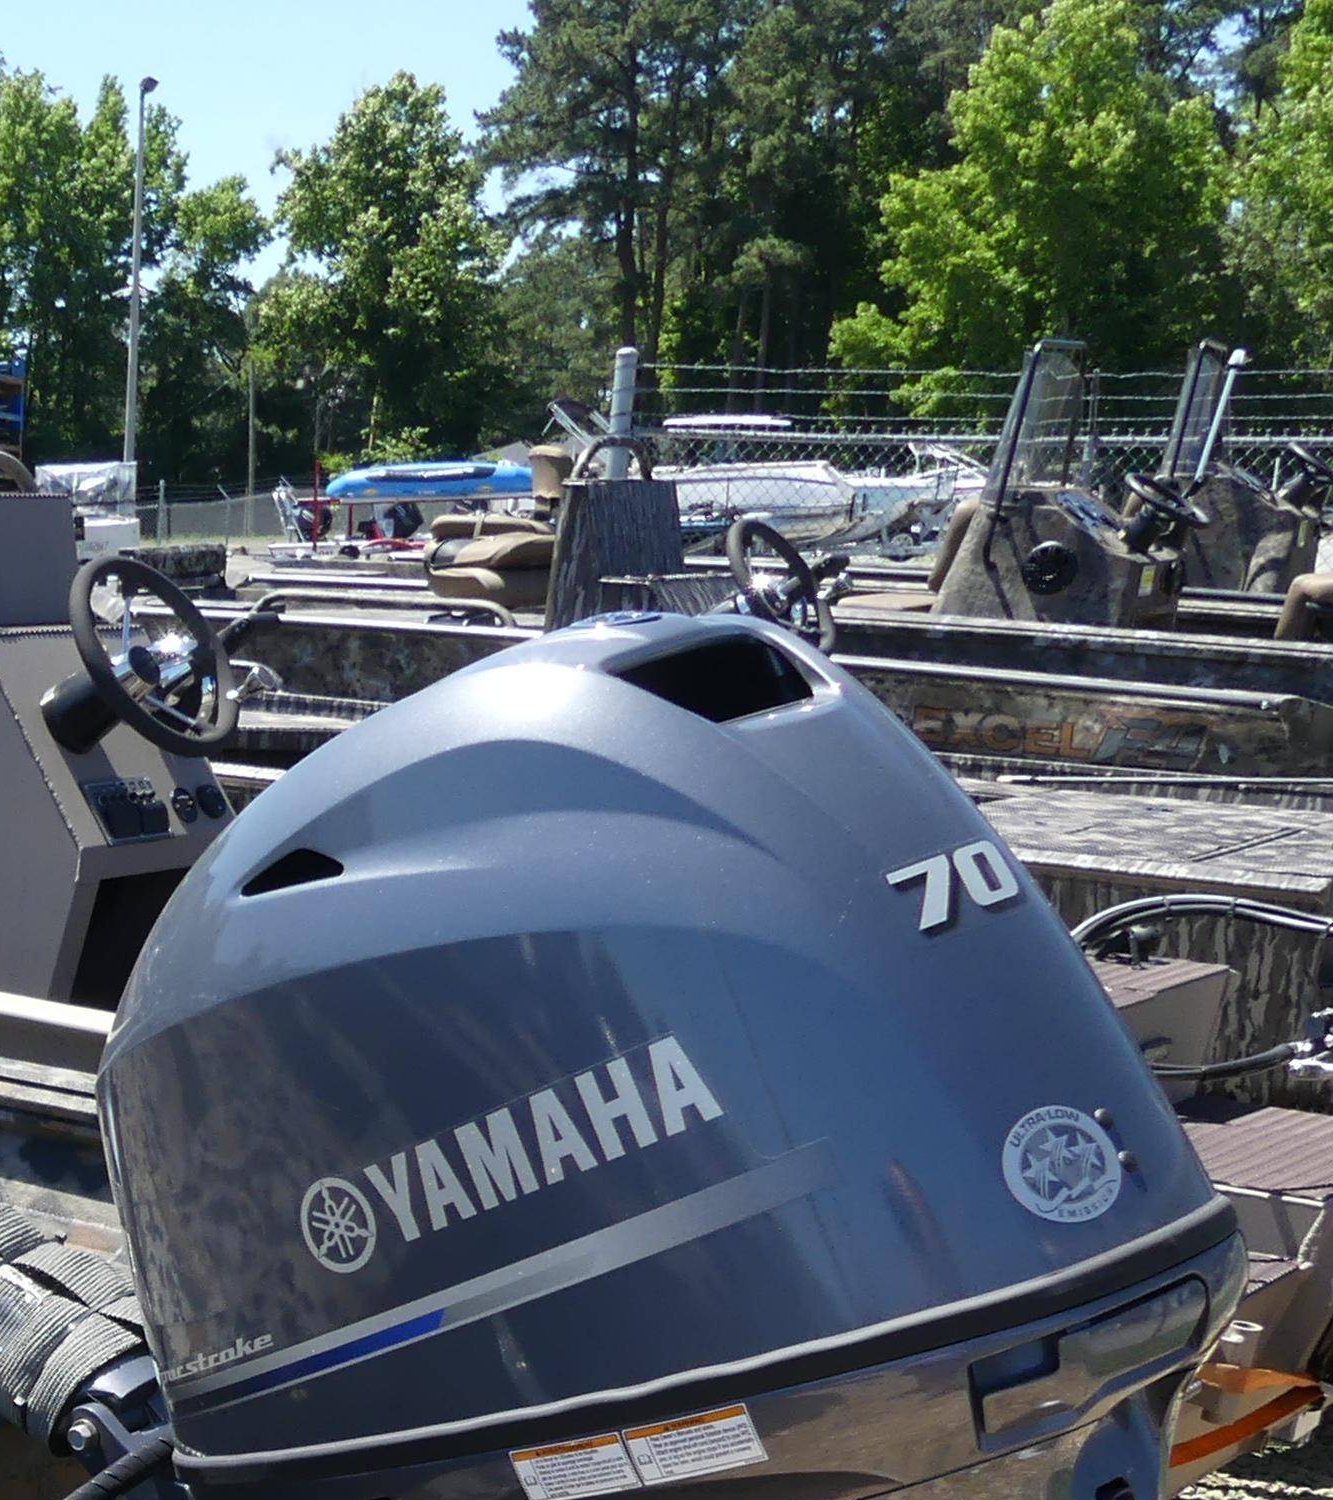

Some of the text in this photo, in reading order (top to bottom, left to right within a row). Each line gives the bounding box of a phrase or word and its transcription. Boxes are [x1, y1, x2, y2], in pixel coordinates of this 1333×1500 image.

[913, 705, 1093, 759] EXCEL
[885, 839, 1020, 932] 70
[365, 1035, 724, 1242] YAMAHA
